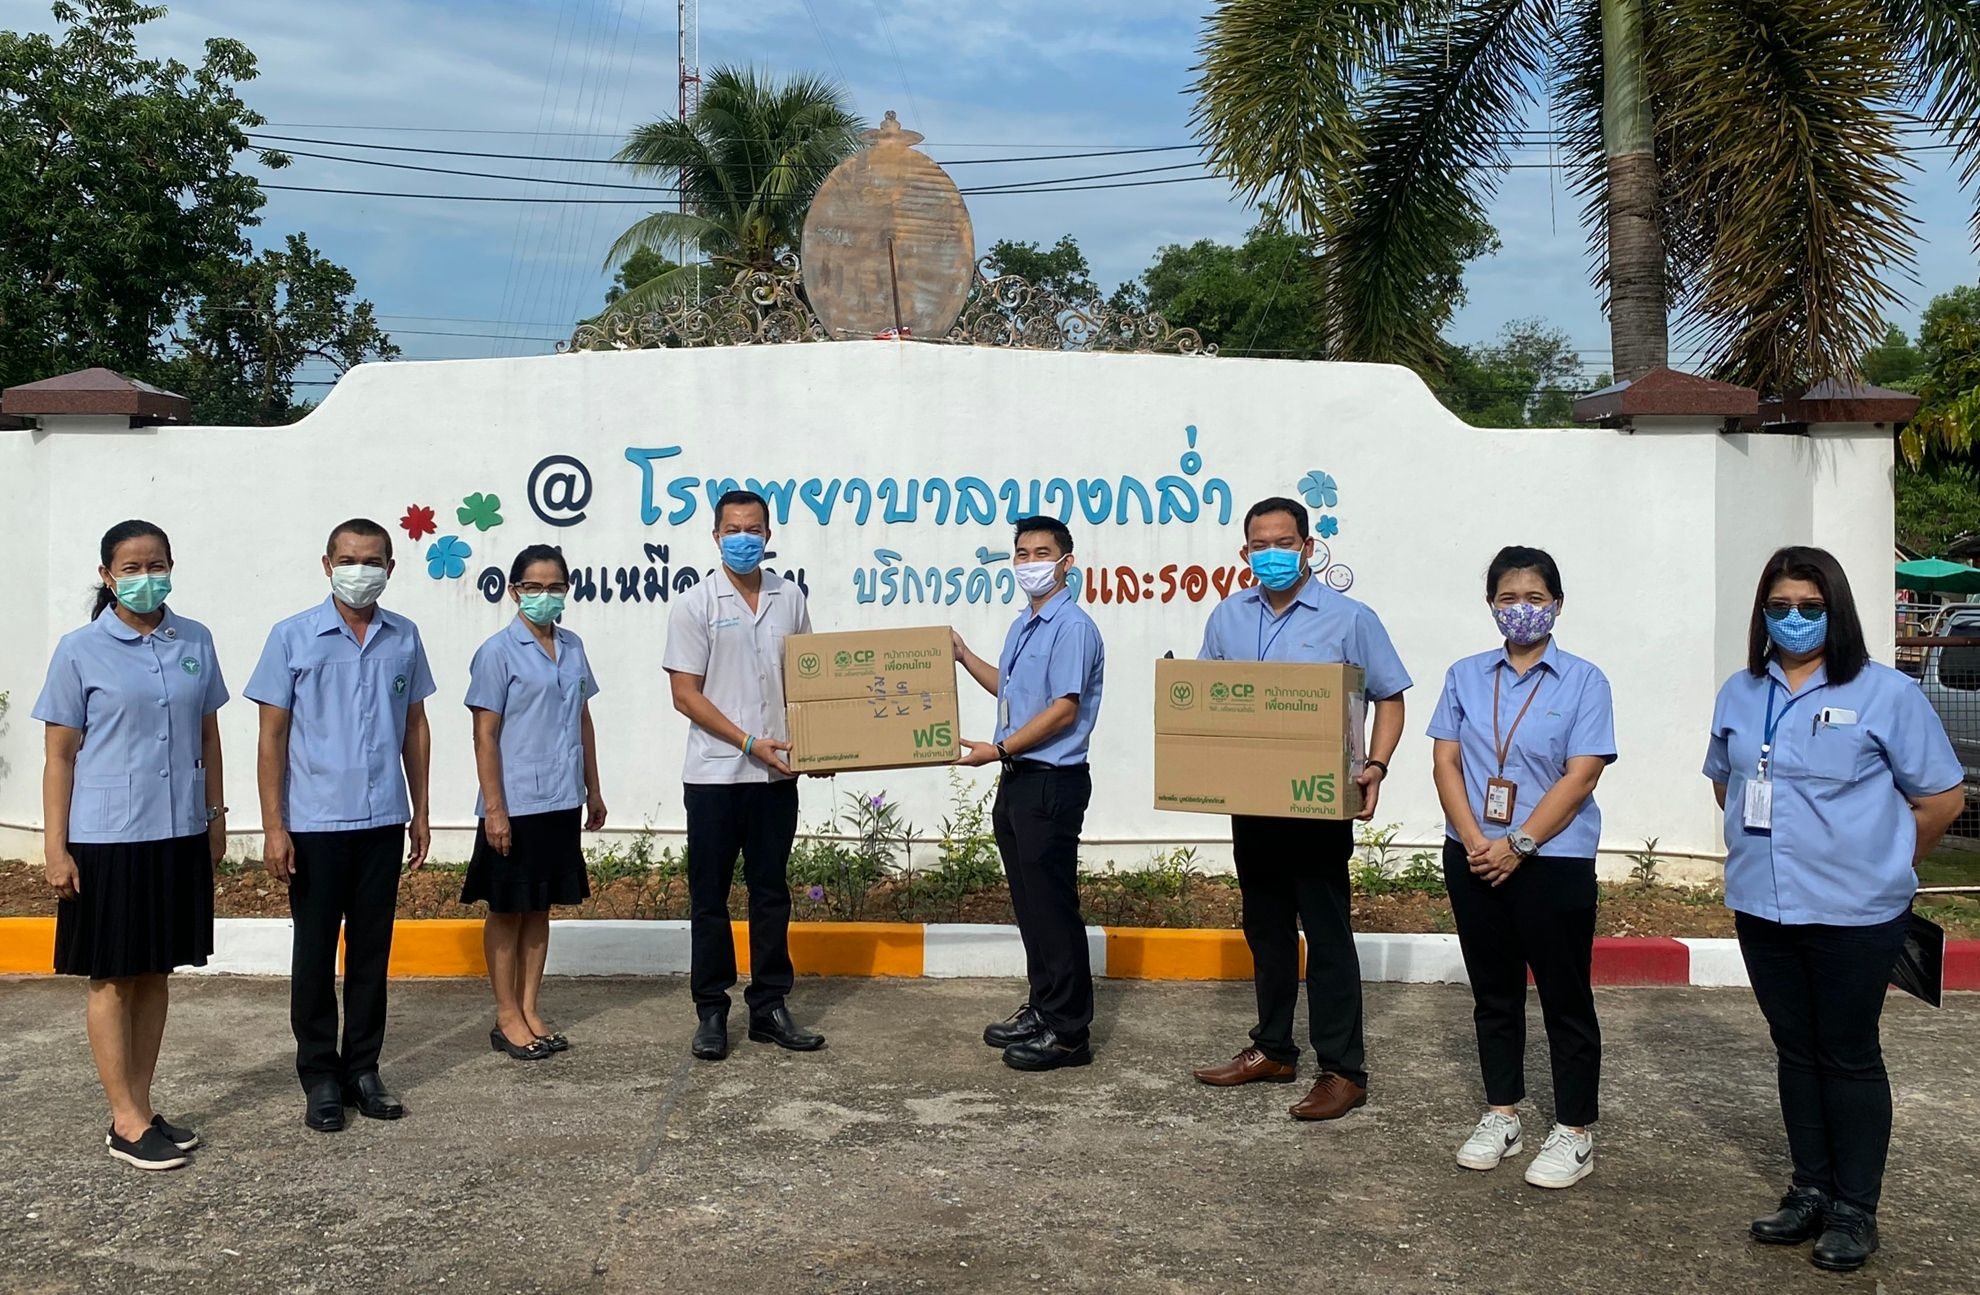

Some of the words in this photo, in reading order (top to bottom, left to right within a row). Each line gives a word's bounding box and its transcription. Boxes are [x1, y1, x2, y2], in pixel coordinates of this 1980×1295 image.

[527, 454, 592, 527] @
[854, 650, 875, 663] CP
[884, 658, 932, 672] เพื่อคนไทย
[1231, 683, 1254, 698] CP
[1265, 698, 1318, 712] เพื่อคนไทย
[913, 720, 952, 748] ฟรี
[1291, 773, 1335, 803] ฟรี
